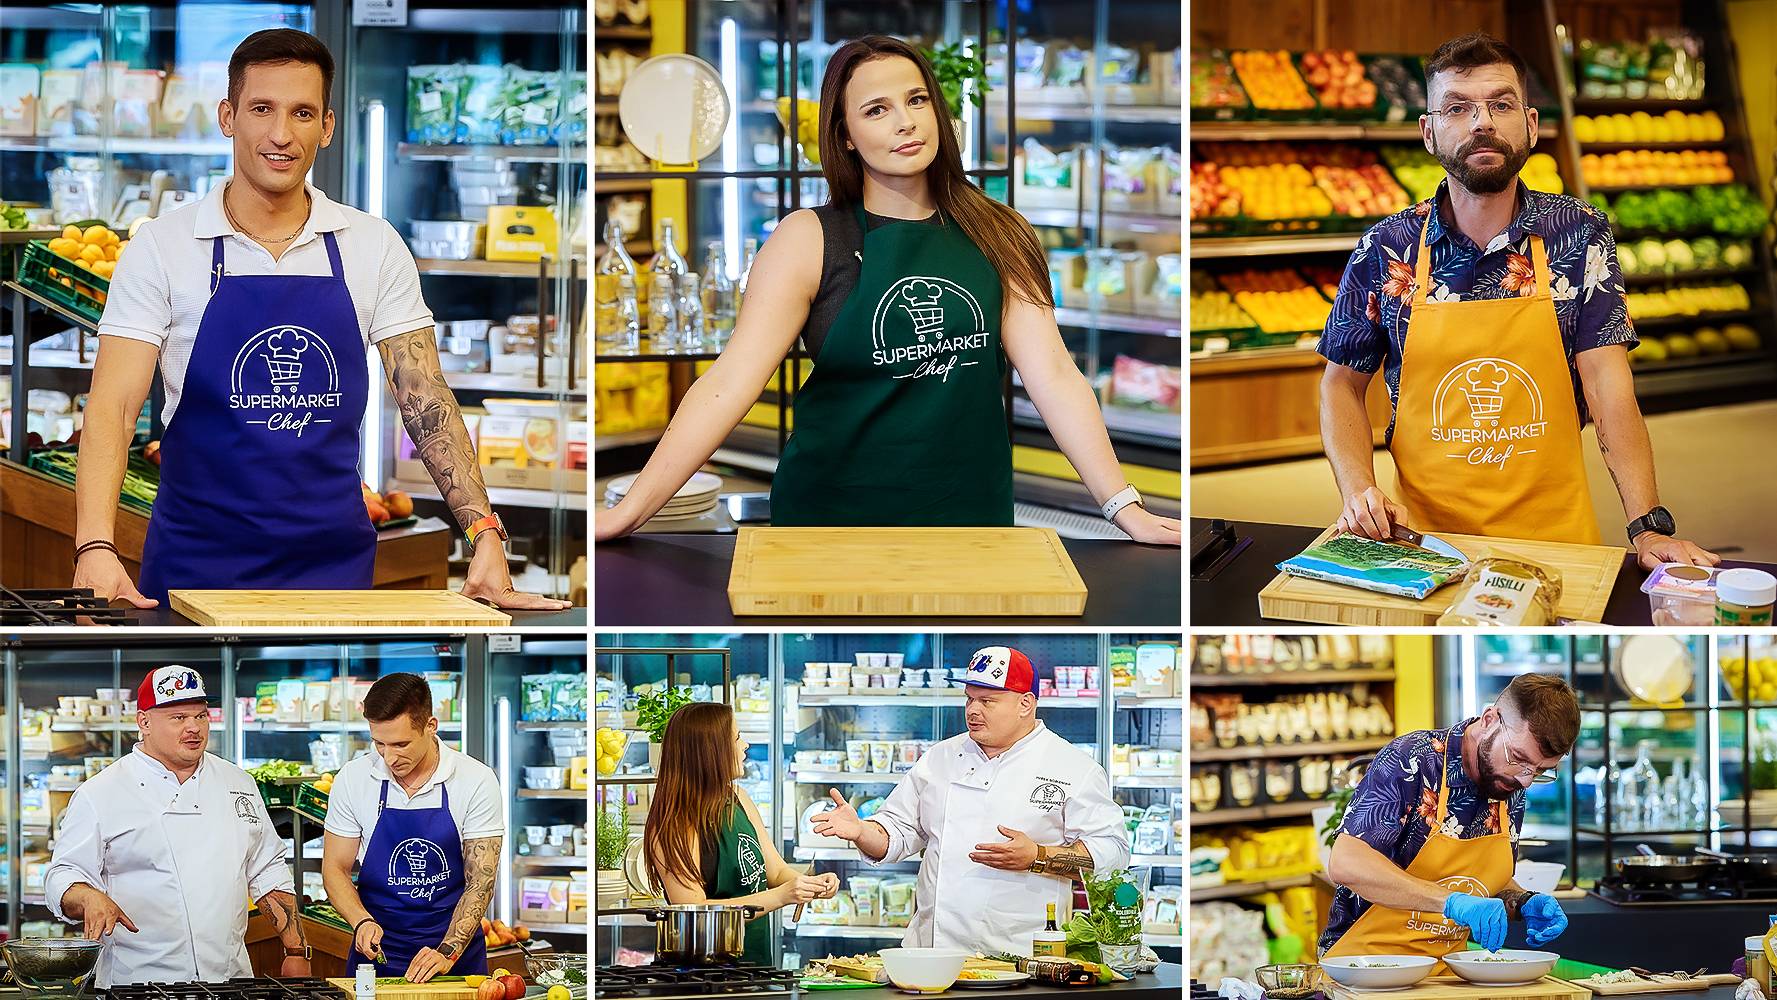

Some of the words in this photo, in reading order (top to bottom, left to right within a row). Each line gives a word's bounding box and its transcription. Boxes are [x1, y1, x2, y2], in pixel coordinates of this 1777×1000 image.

[872, 332, 990, 366] SUPERMARKET
[912, 354, 958, 383] Chef
[229, 392, 343, 409] SUPERMARKET
[267, 411, 313, 438] Chef
[1430, 421, 1548, 444] SUPERMARKET
[1467, 444, 1514, 471] Chef
[1484, 576, 1526, 593] FUSILLI
[387, 869, 452, 886] SUPERMARKET
[410, 885, 436, 902] Chef
